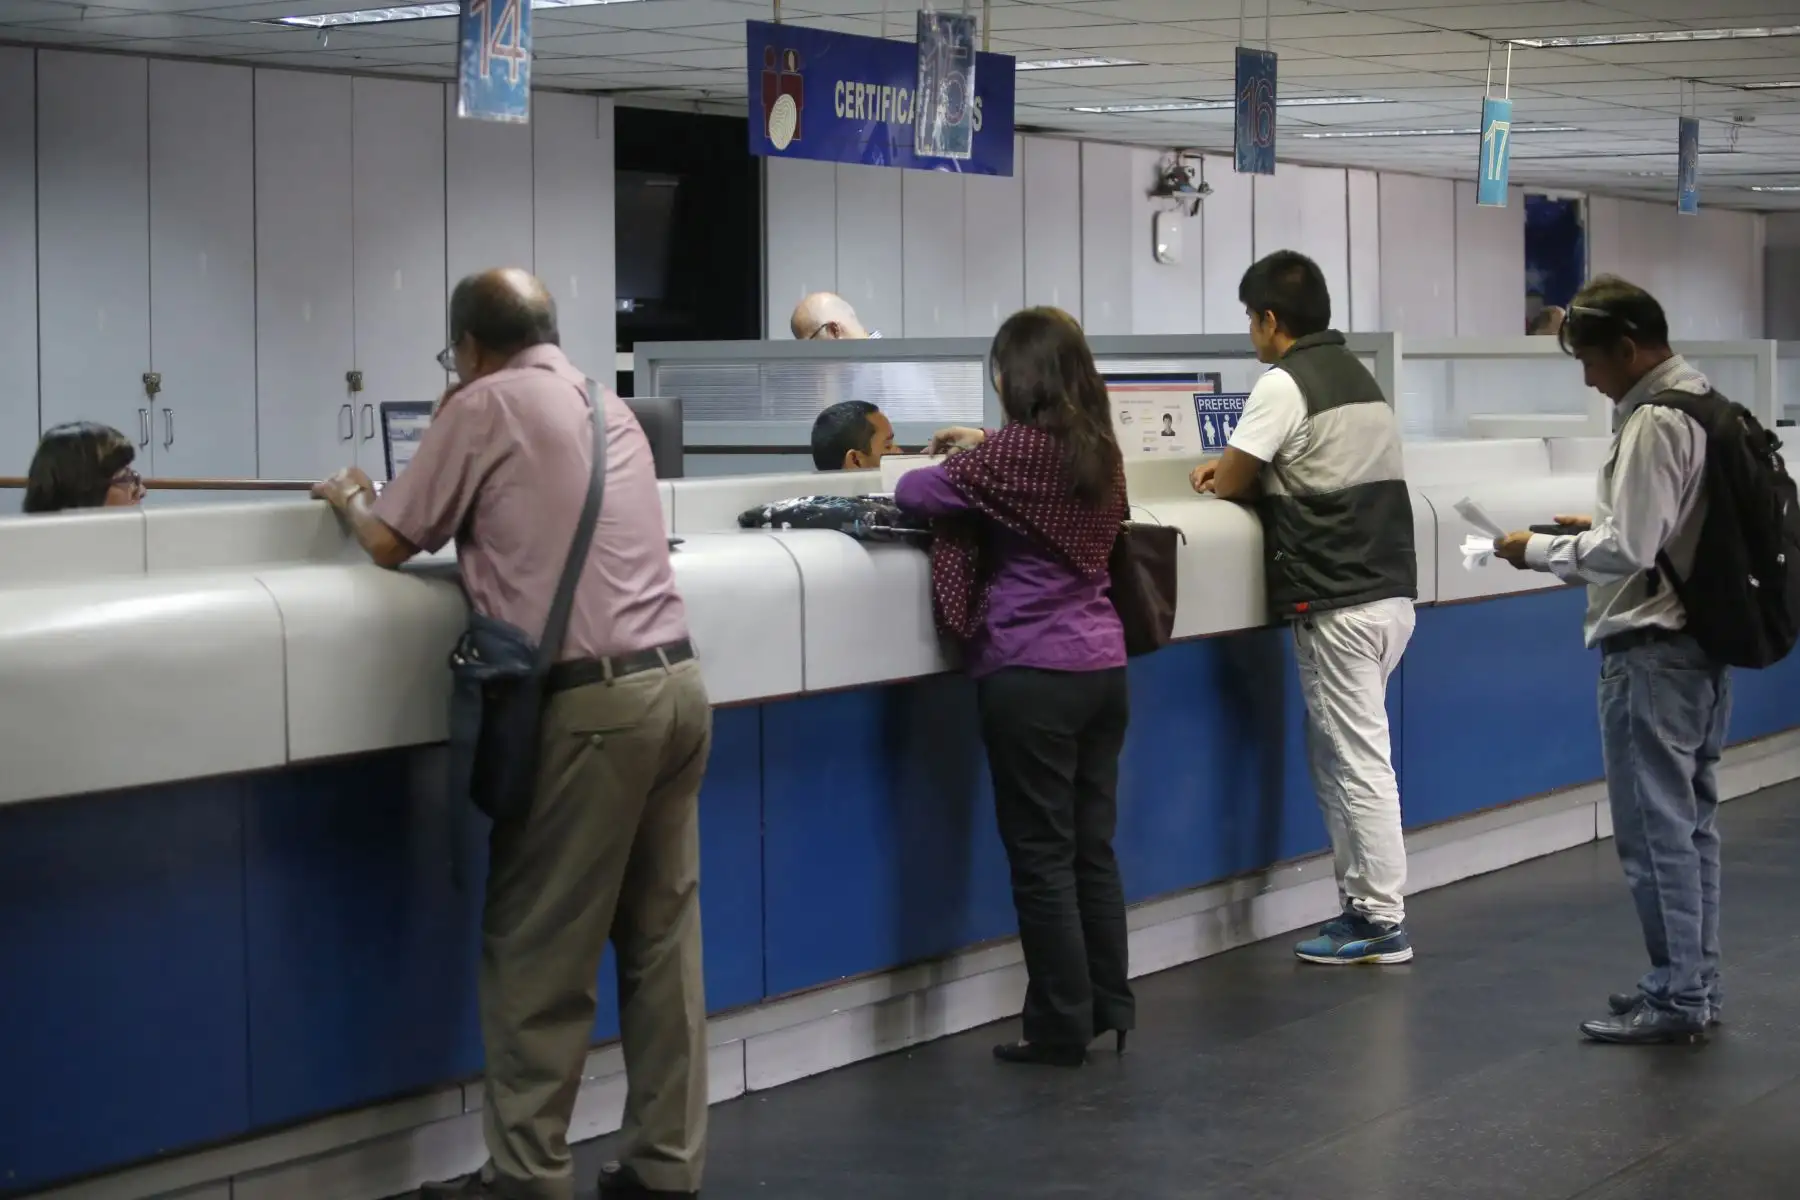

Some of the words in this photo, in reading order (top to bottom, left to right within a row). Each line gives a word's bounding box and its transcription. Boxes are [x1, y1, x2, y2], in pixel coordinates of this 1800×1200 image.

[470, 0, 526, 82] 14
[1240, 77, 1273, 148] 16
[1484, 120, 1510, 181] 17
